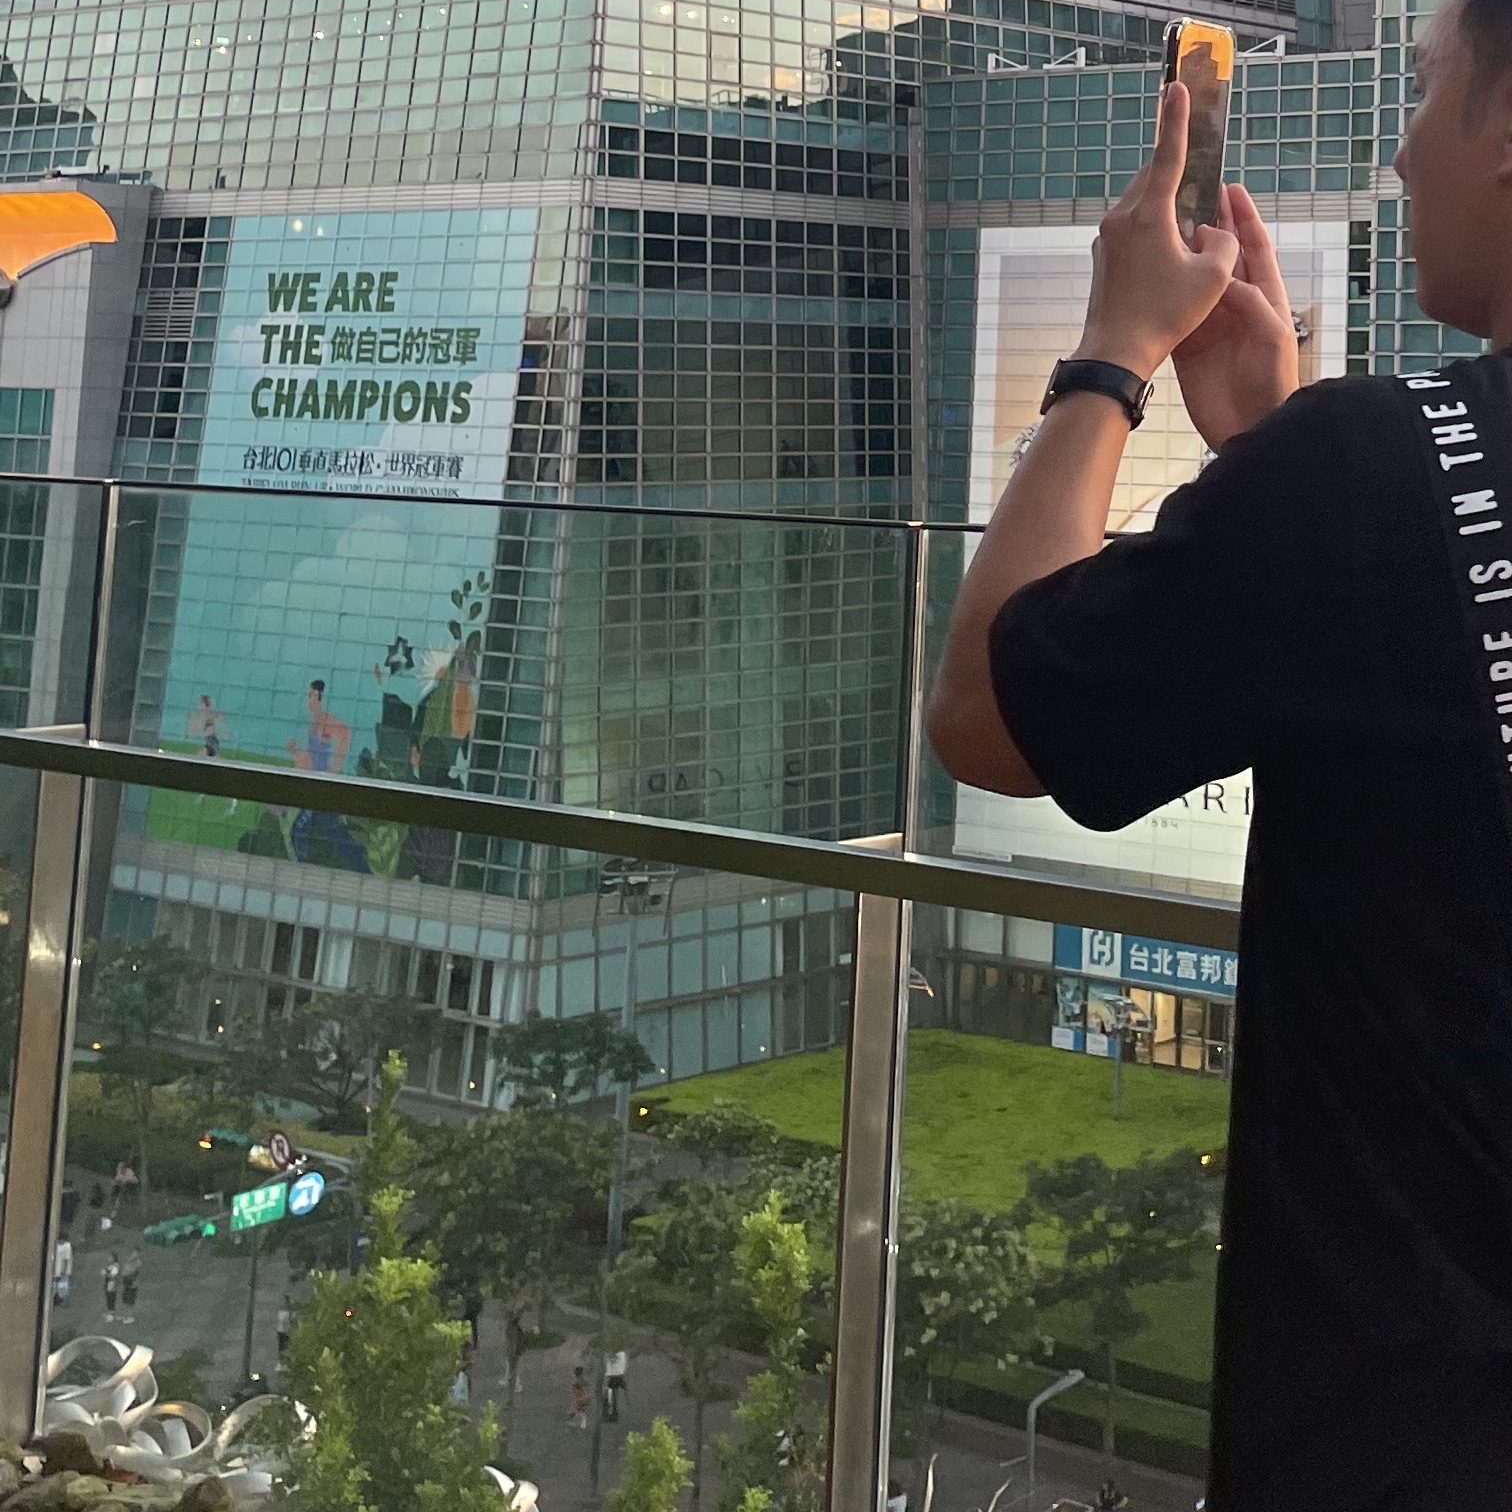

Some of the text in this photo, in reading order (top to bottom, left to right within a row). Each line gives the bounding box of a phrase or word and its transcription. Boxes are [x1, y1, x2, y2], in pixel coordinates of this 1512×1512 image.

[267, 271, 398, 312] WE ARE
[260, 324, 480, 365] THE 做自己的冠軍
[251, 377, 473, 423] CHAMPIONS
[1421, 401, 1484, 471] THE
[1451, 489, 1503, 535] IN
